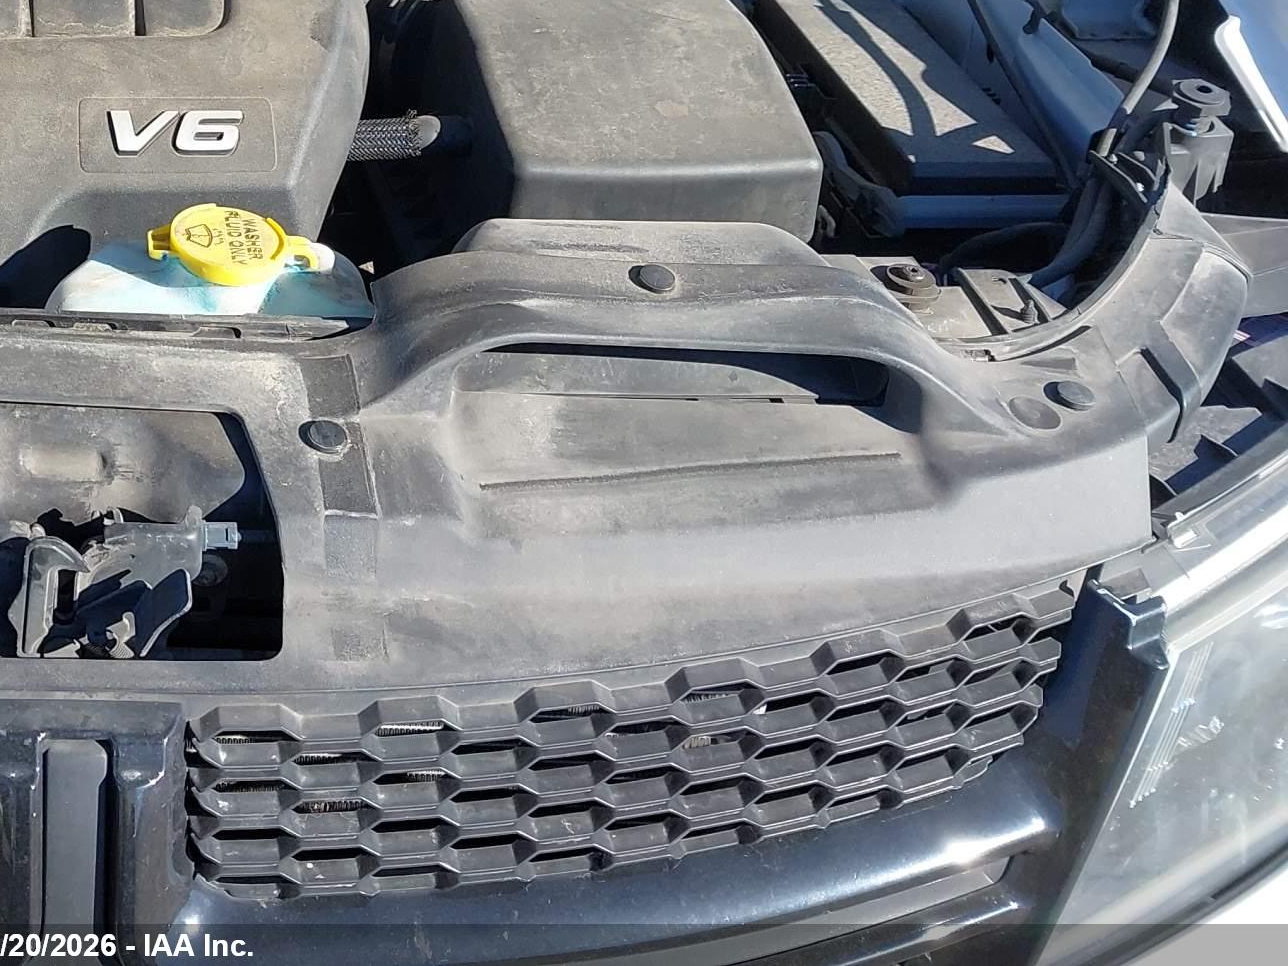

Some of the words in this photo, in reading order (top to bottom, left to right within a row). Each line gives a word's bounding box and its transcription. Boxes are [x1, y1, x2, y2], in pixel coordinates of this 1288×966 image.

[106, 110, 244, 156] V6
[223, 210, 243, 238] FLUID
[242, 218, 263, 260] WASHER
[228, 239, 249, 265] ONLY
